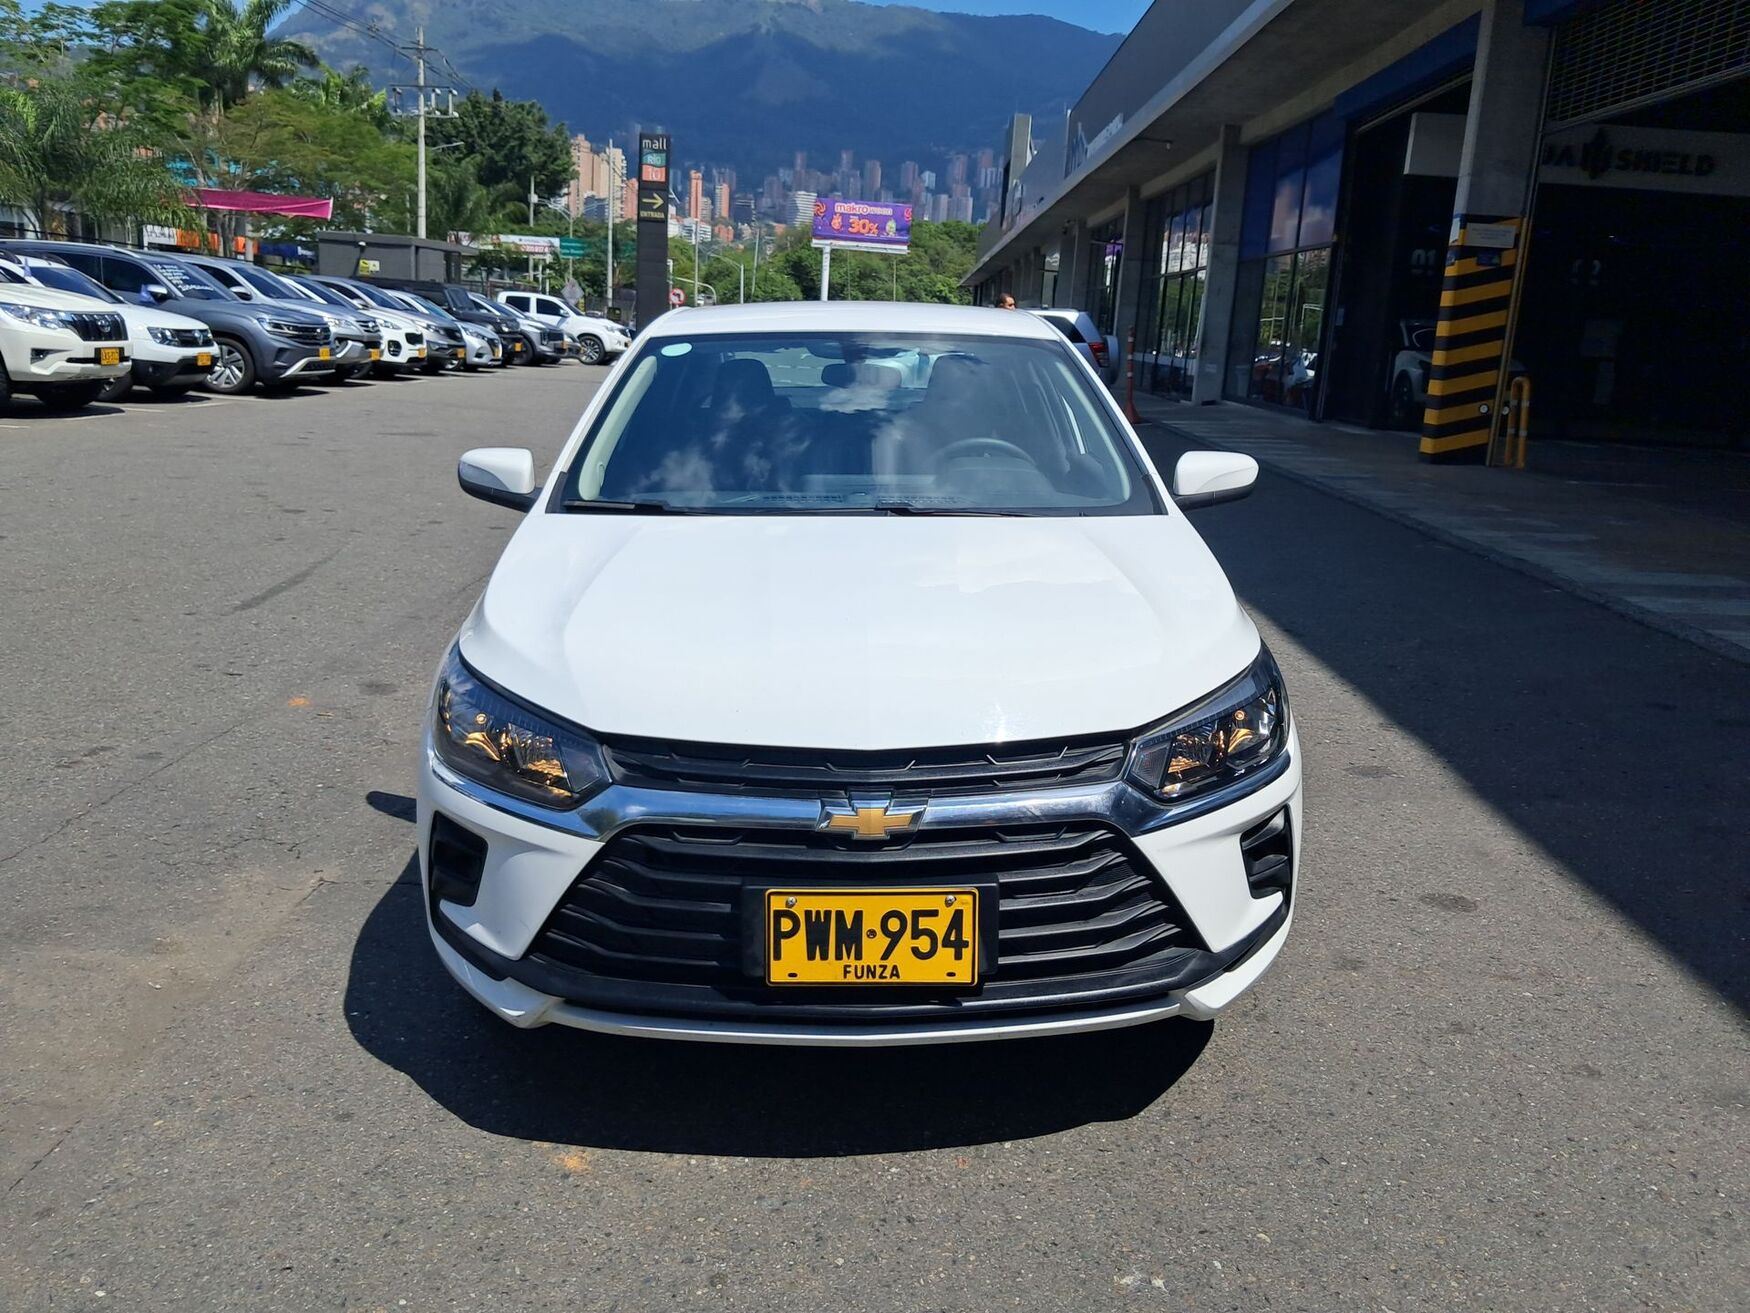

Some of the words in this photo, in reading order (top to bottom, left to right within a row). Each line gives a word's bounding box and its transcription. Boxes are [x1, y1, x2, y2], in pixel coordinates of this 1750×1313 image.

[642, 137, 667, 150] mall
[848, 218, 879, 235] 30%
[843, 964, 900, 980] FUNZA
